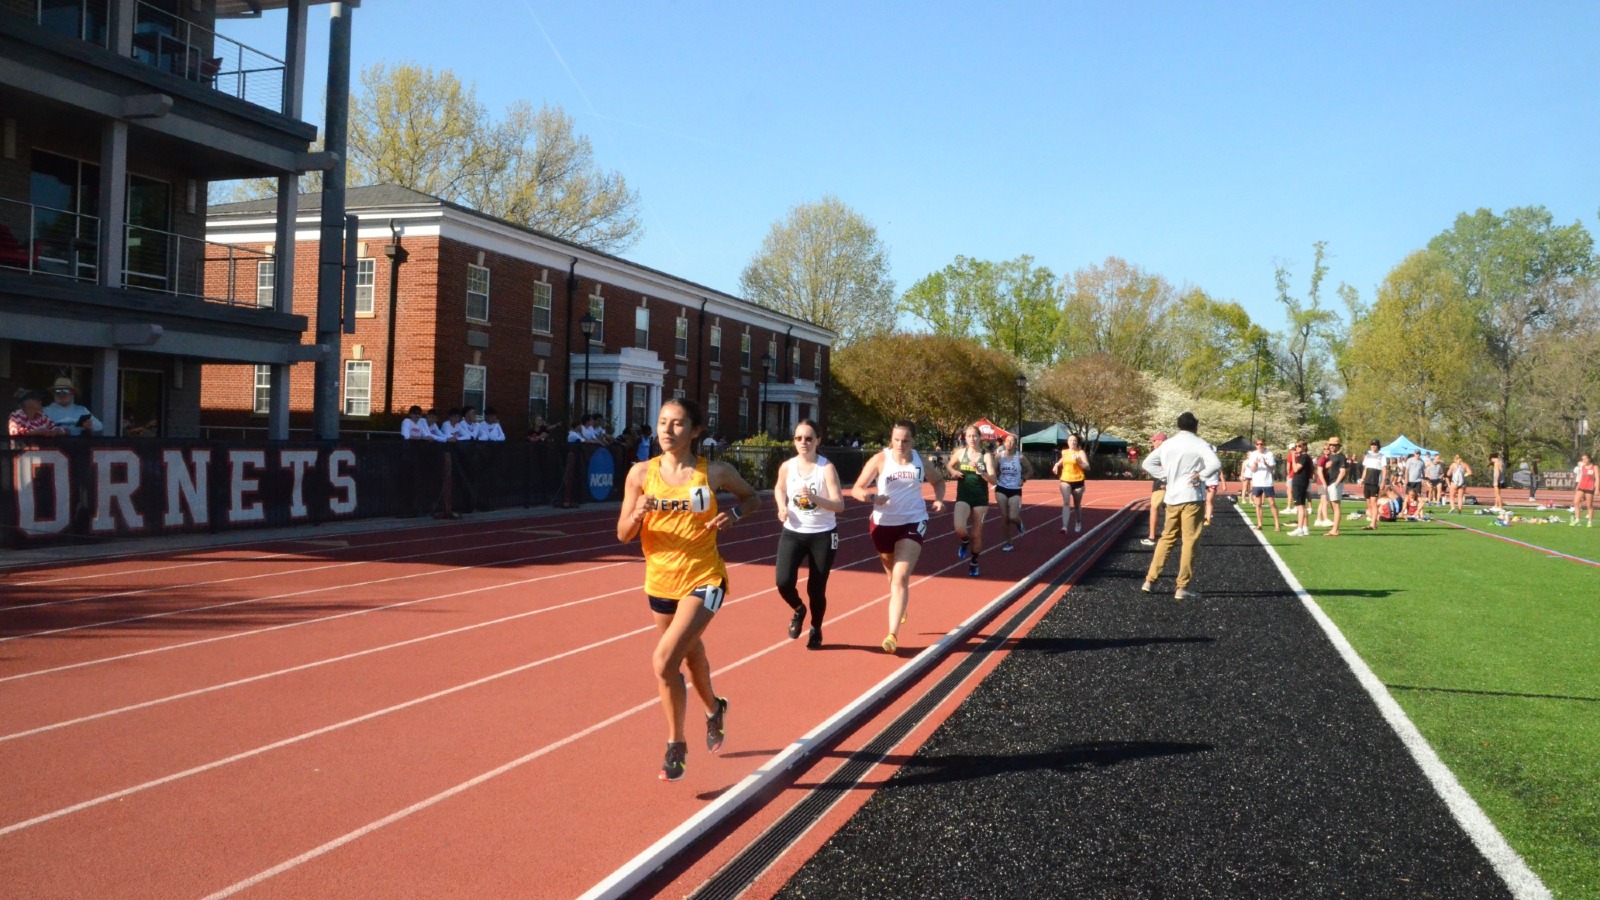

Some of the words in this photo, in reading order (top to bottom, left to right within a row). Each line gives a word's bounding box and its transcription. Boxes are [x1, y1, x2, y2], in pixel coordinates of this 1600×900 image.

[590, 473, 613, 487] NCAA
[915, 466, 921, 479] 7
[13, 447, 358, 537] ORNETS
[695, 488, 704, 511] 1
[711, 588, 719, 610] 1
